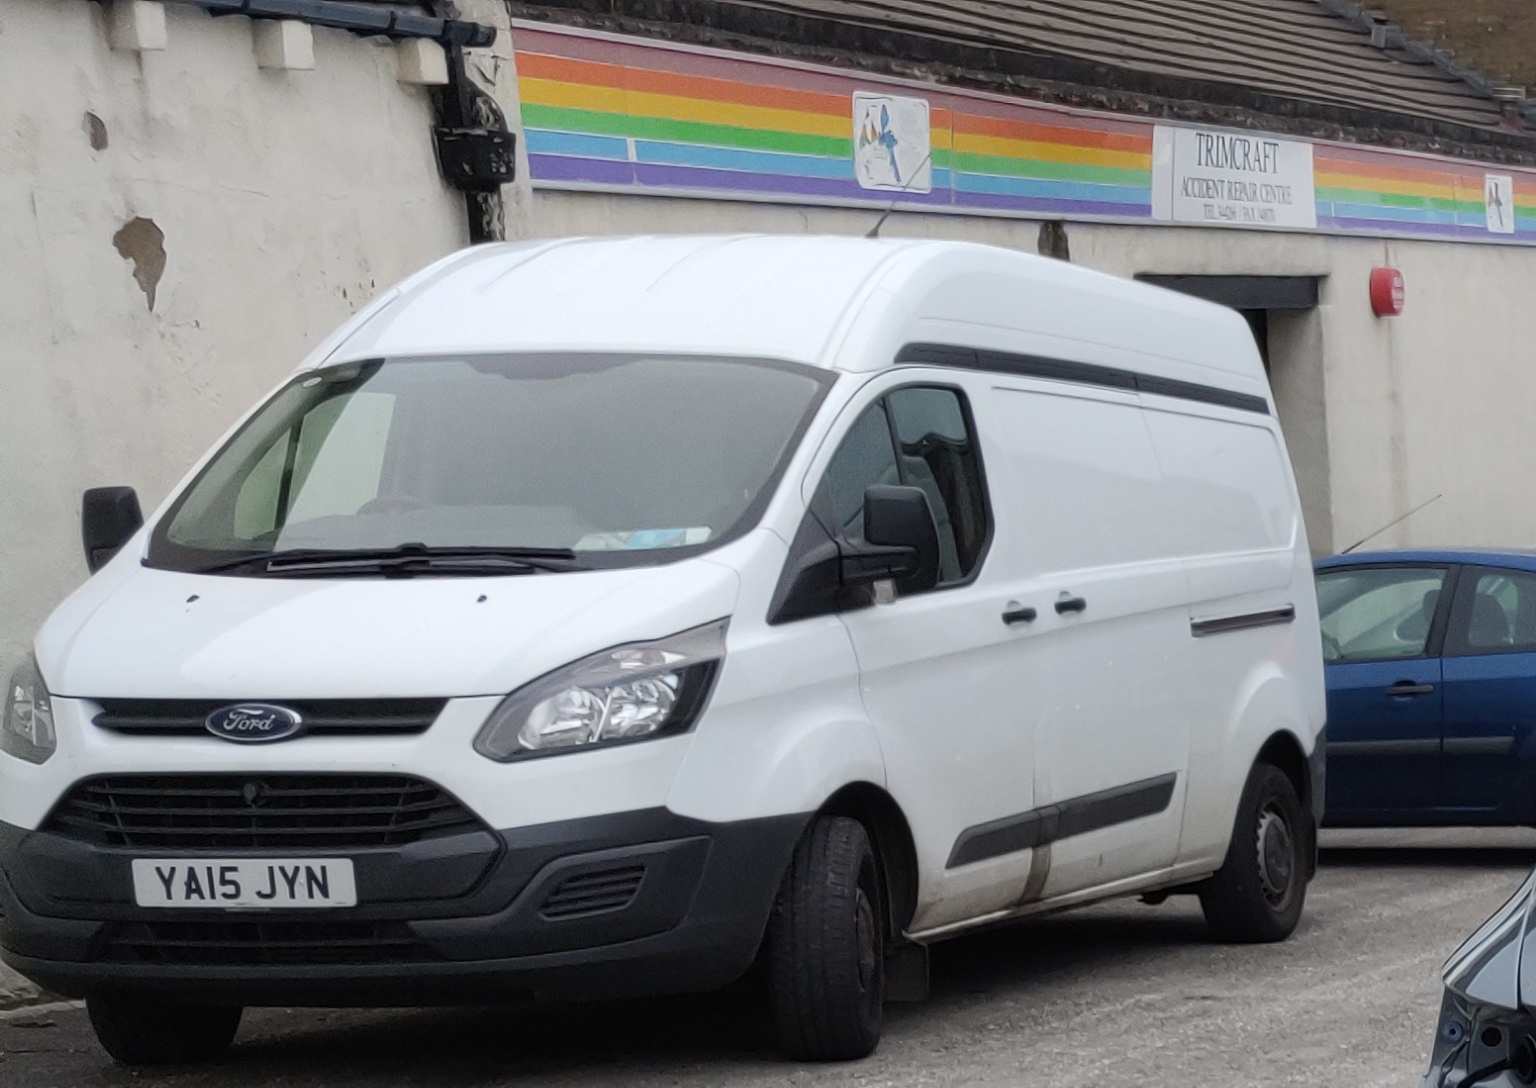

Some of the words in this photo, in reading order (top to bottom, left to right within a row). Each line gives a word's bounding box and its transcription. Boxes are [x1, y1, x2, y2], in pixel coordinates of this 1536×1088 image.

[1196, 132, 1279, 174] TRIMCRAFT
[1181, 176, 1226, 199] ACCIDENT
[1227, 180, 1259, 202] REPAIR
[1260, 184, 1293, 205] CENTRE
[223, 708, 276, 731] Ford
[155, 866, 242, 900] YA15
[255, 865, 330, 899] JYN
